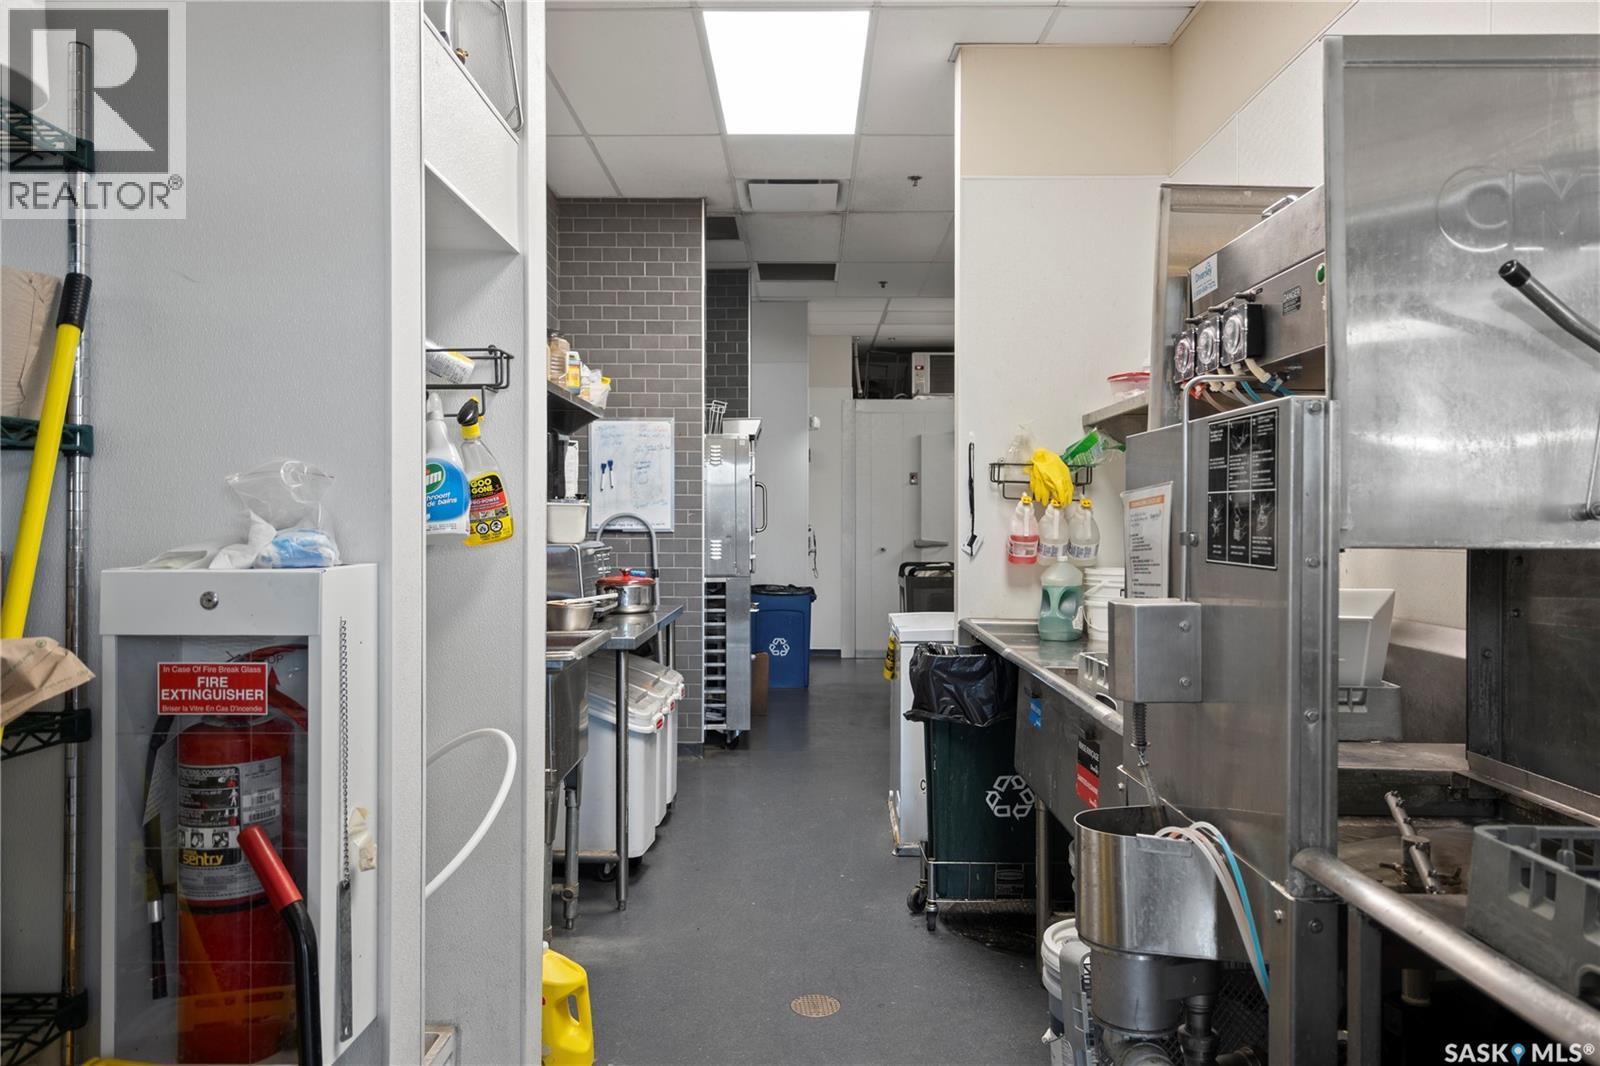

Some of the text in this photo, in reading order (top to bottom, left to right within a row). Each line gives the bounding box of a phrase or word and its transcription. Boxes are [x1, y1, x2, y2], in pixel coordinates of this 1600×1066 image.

[470, 478, 492, 488] GOO
[471, 485, 494, 495] GONE
[163, 665, 262, 673] In Case Of Fire Break Glass
[197, 676, 229, 688] FIRE
[161, 688, 264, 701] EXTINGUISHER
[162, 705, 181, 713] Briser
[189, 705, 205, 713] Vitre
[206, 705, 215, 713] En
[216, 705, 229, 713] Cas
[182, 851, 224, 866] sentry
